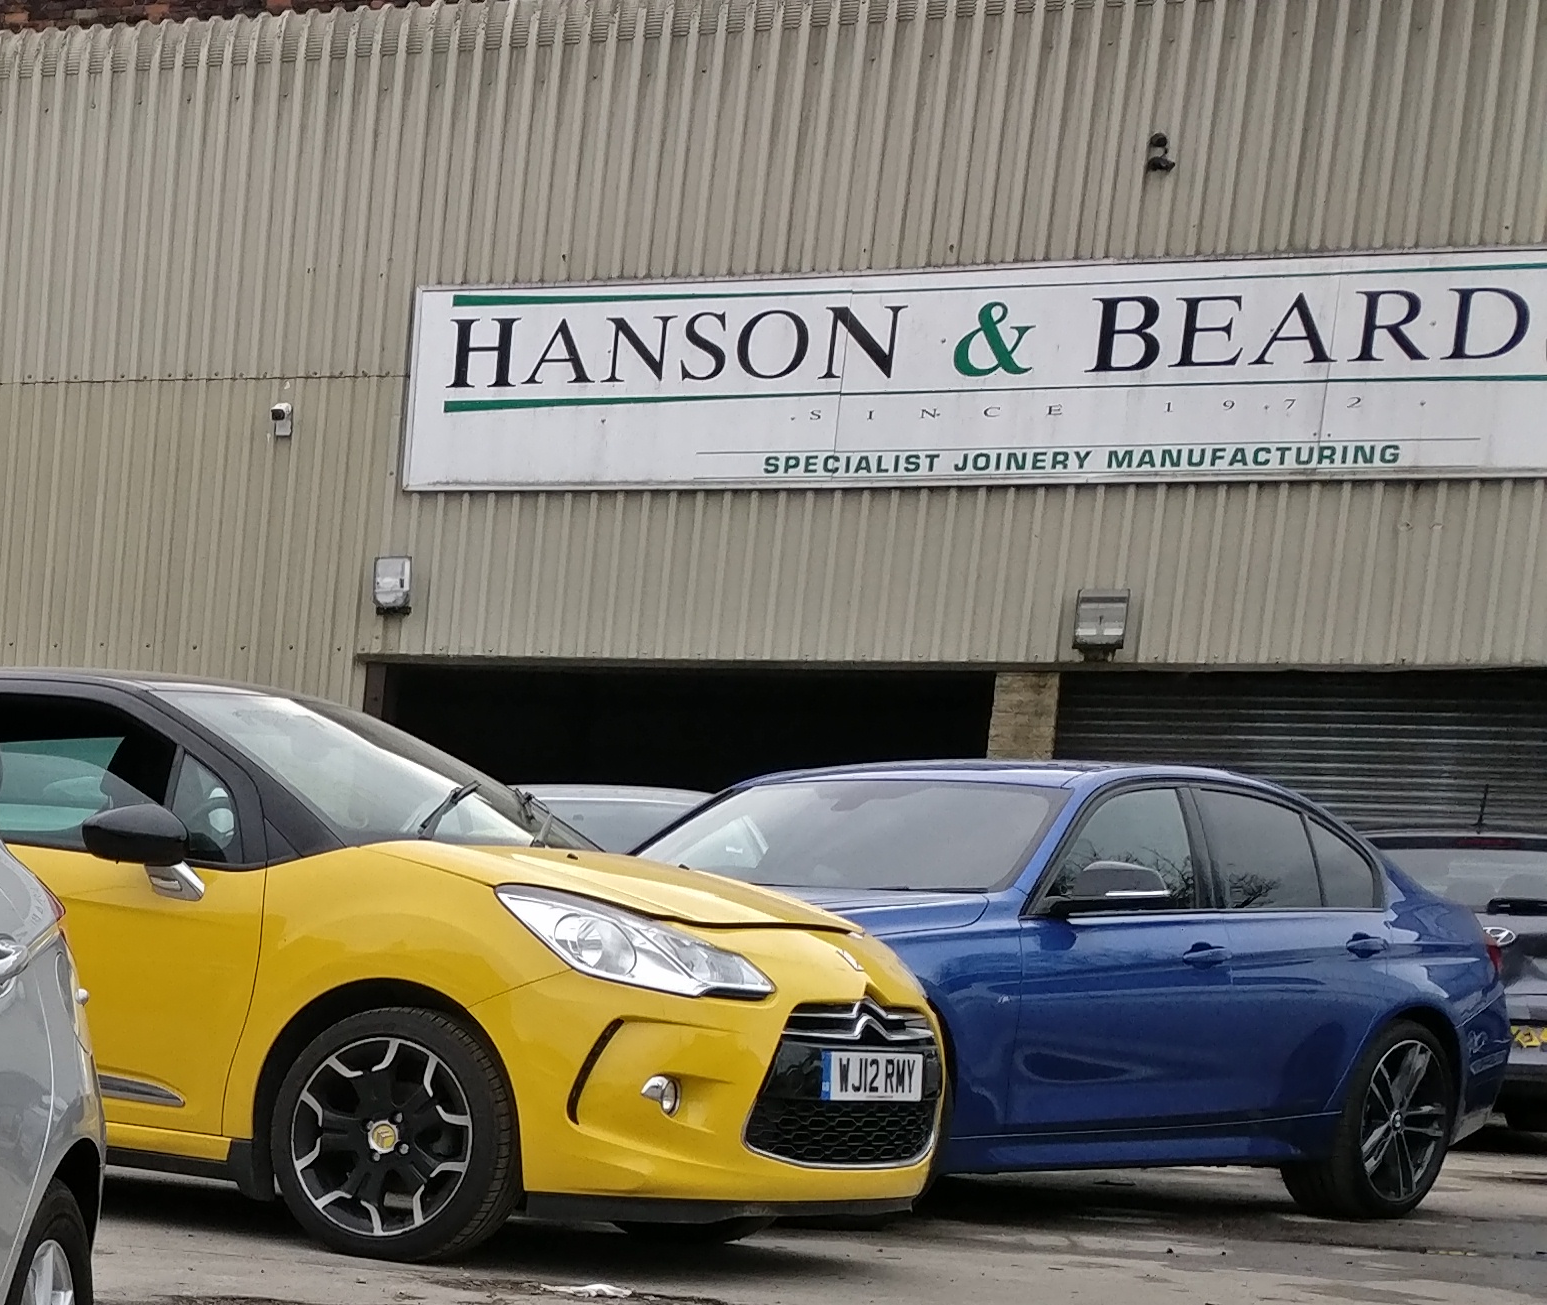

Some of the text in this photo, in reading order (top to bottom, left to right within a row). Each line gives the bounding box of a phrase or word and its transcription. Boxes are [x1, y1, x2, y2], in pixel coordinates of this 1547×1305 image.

[445, 287, 1530, 389] HANSON & BEARD
[809, 396, 1362, 421] SINCE 1972
[763, 444, 1400, 475] SPECIALIST JOINERY MANUFACTURING
[839, 1057, 916, 1094] WJ12 RMY
